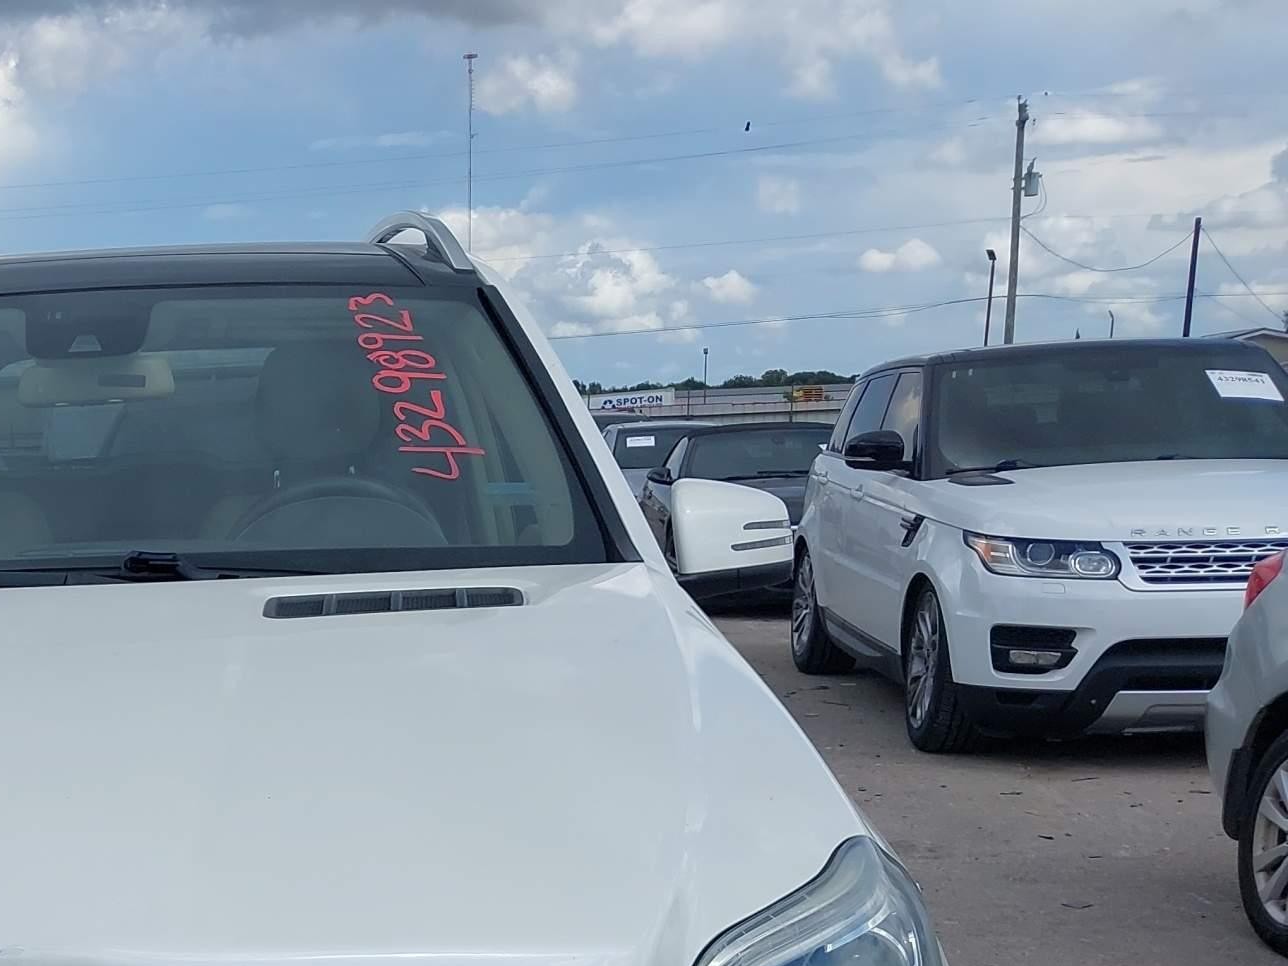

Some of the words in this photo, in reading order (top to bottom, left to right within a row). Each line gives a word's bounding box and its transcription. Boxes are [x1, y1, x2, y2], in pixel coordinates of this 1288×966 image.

[348, 293, 486, 480] 43298923
[615, 394, 663, 407] SPOT-ON
[1130, 526, 1241, 537] RANGE
